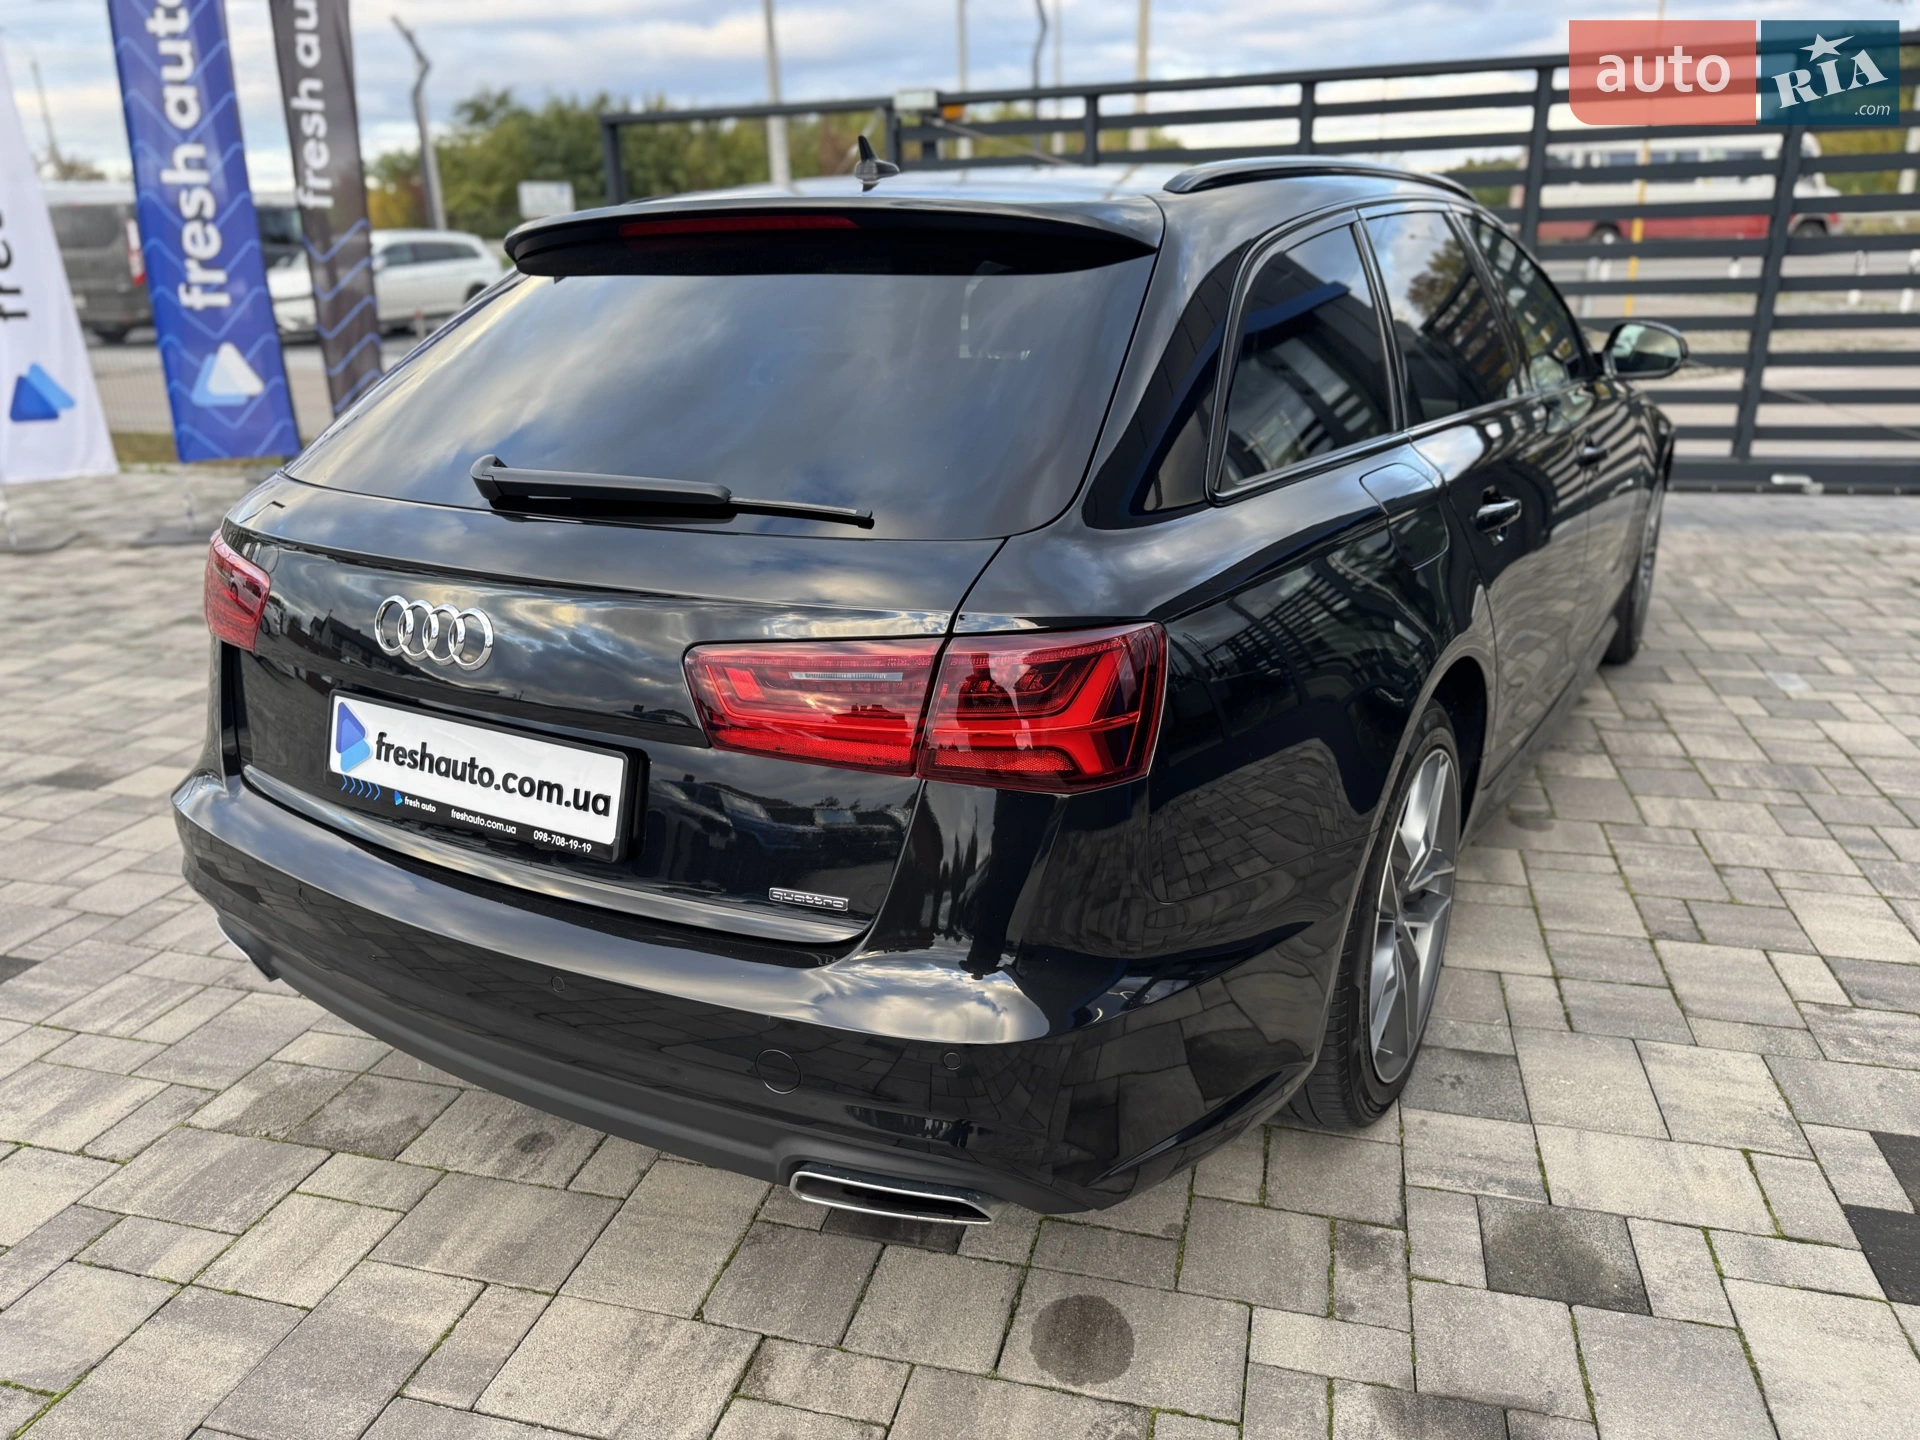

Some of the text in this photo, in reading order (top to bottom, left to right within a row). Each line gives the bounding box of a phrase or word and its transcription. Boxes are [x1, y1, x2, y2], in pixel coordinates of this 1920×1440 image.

[145, 0, 232, 310] fresh aut
[290, 78, 335, 209] fresh
[375, 731, 613, 817] freshauto.com.ua
[404, 795, 592, 854] fresh auto freshauto.com.ua 098-708-19-19
[771, 890, 845, 909] quattro
